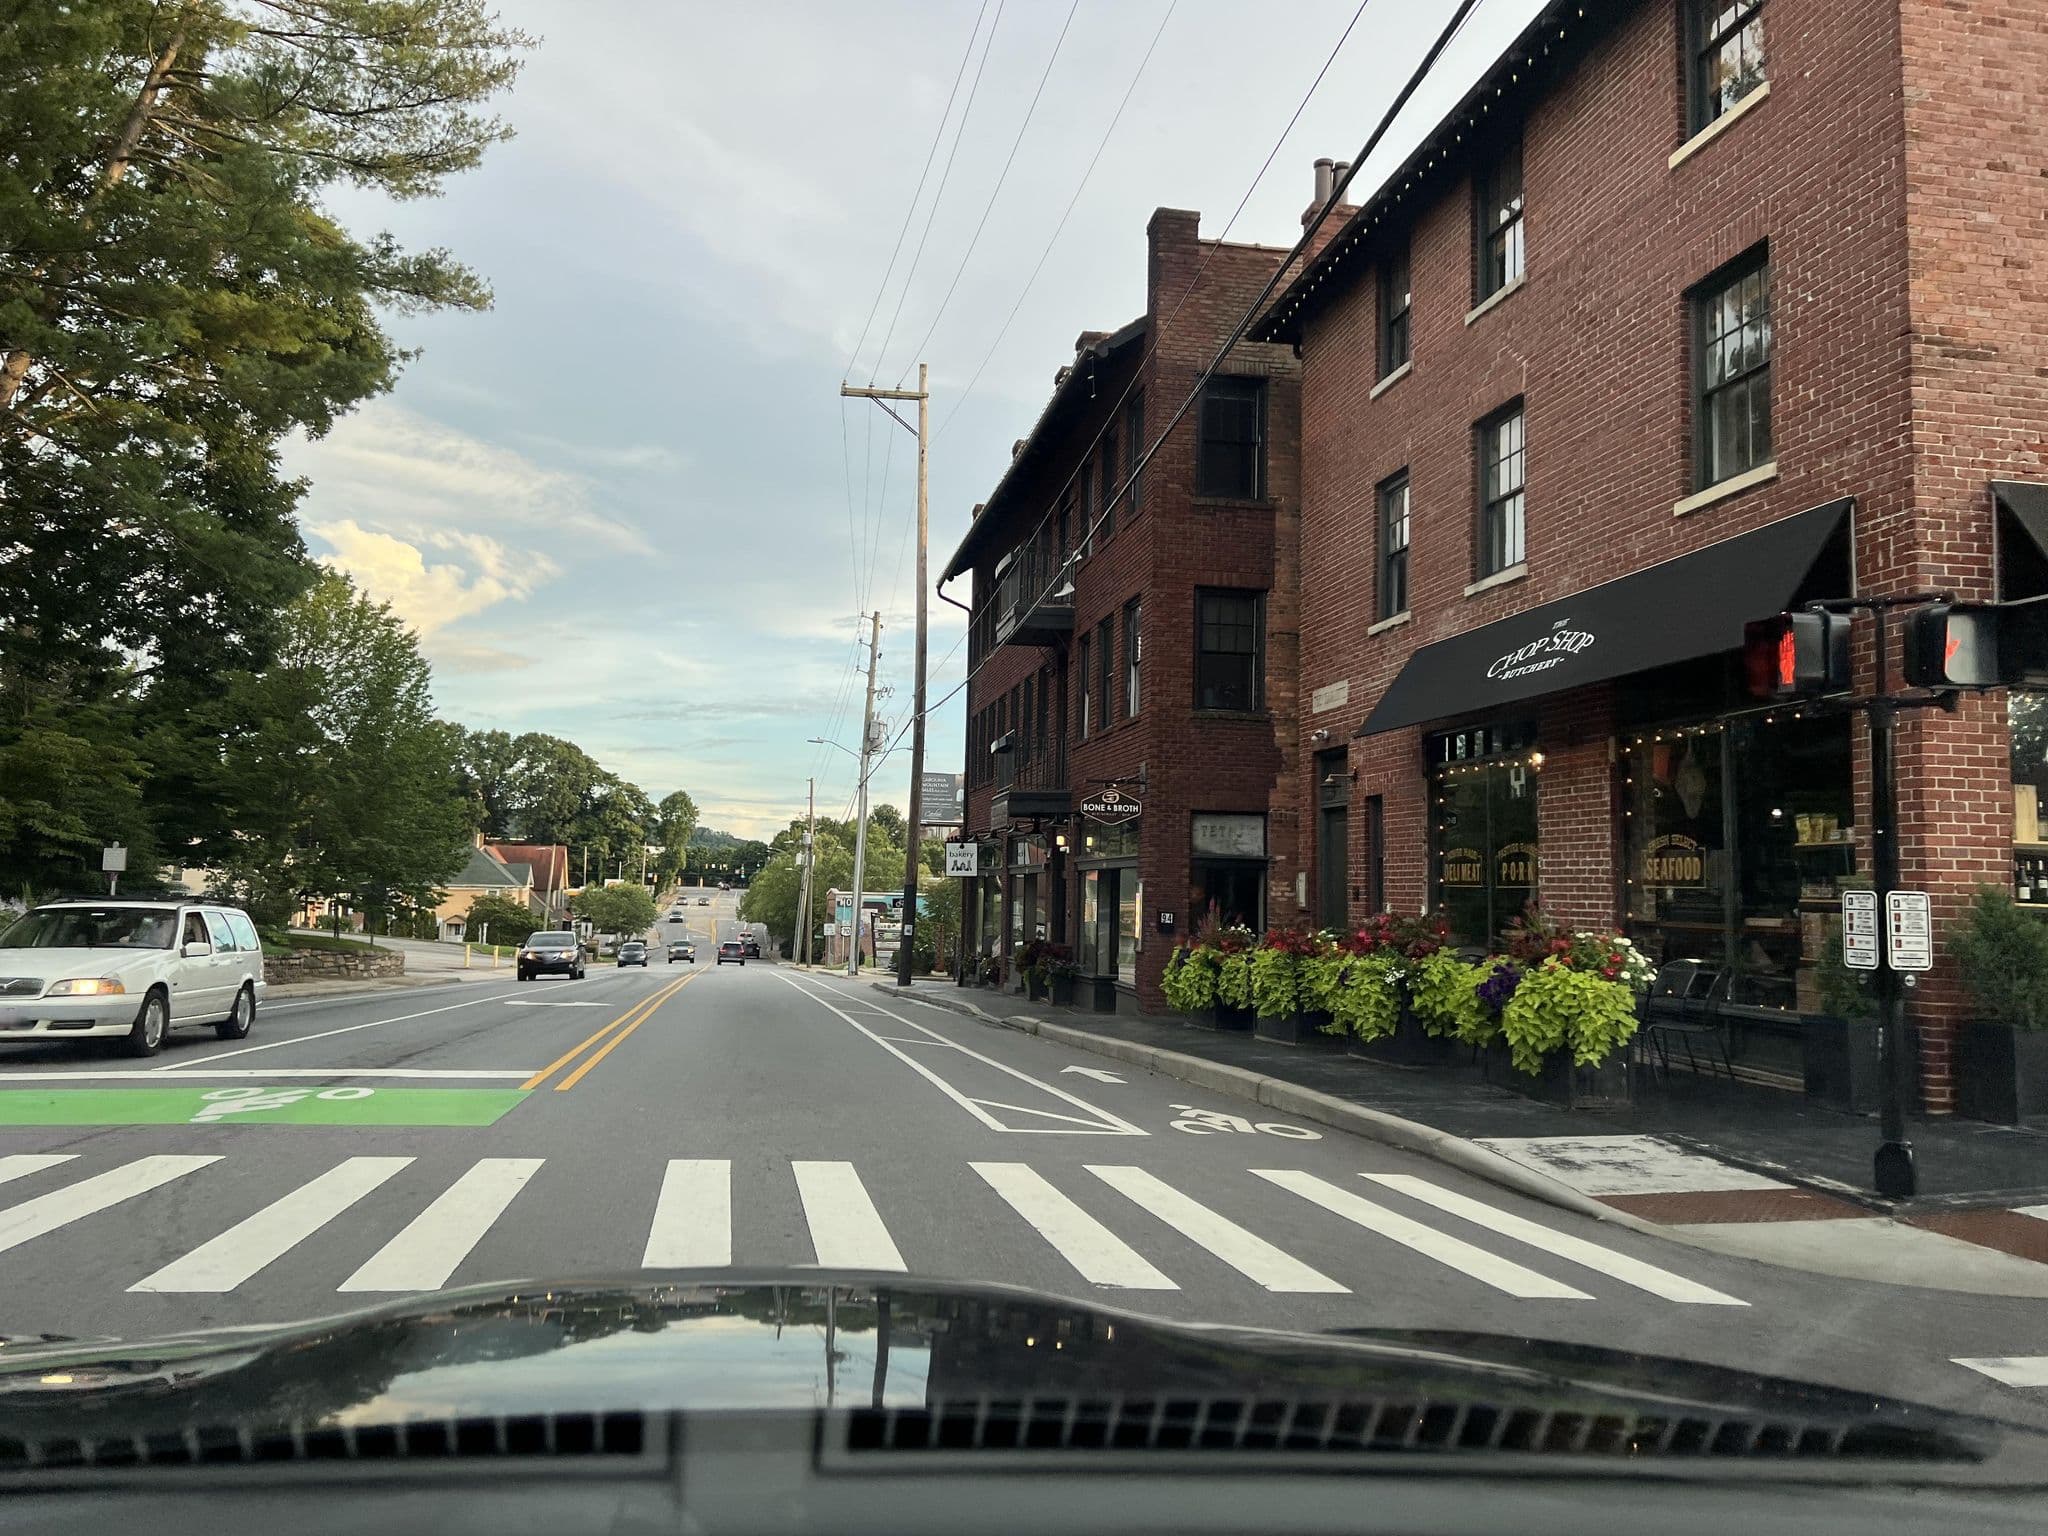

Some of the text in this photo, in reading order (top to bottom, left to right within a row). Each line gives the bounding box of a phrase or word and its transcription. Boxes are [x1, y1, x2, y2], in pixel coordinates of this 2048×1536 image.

[1487, 630, 1595, 678] CHOP SHOP
[1083, 803, 1106, 812] BONE
[1113, 804, 1139, 813] BROTH
[949, 850, 974, 859] bakery
[1461, 863, 1481, 882] MEAT
[1647, 856, 1701, 880] SEAFOOD
